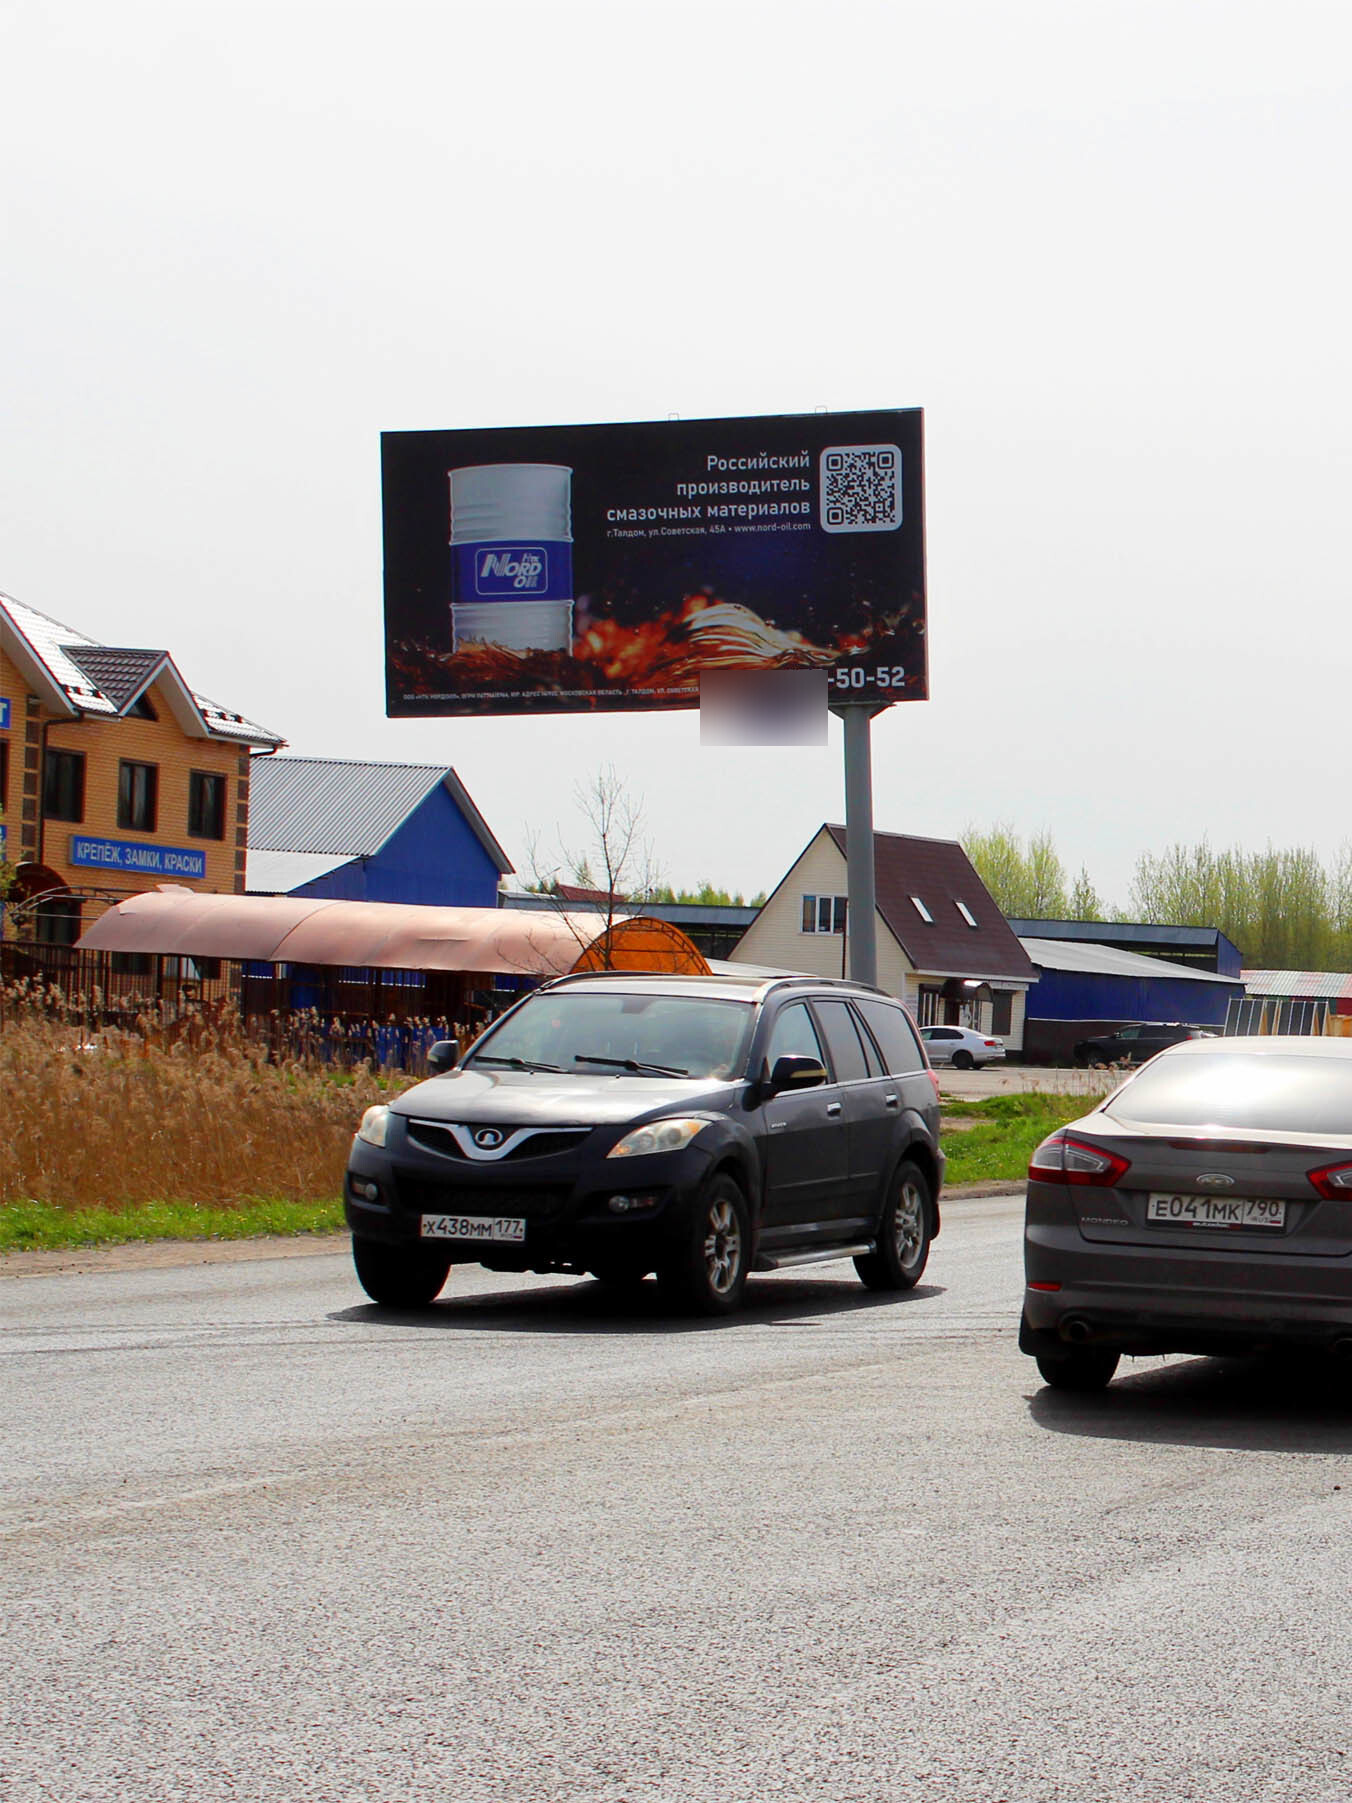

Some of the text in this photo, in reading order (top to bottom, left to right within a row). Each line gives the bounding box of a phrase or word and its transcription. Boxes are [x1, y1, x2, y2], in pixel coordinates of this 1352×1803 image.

[707, 450, 811, 472] Российский
[676, 479, 811, 499] производитель
[606, 502, 811, 521] смазочных материалов
[734, 522, 811, 533] www.nord-oil.com
[77, 842, 202, 873] КРЕПЁЖ, ЗАМКИ, КРАСКИ
[1155, 1196, 1280, 1221] Е041МК 790
[426, 1218, 521, 1237] Х438ММ 177
